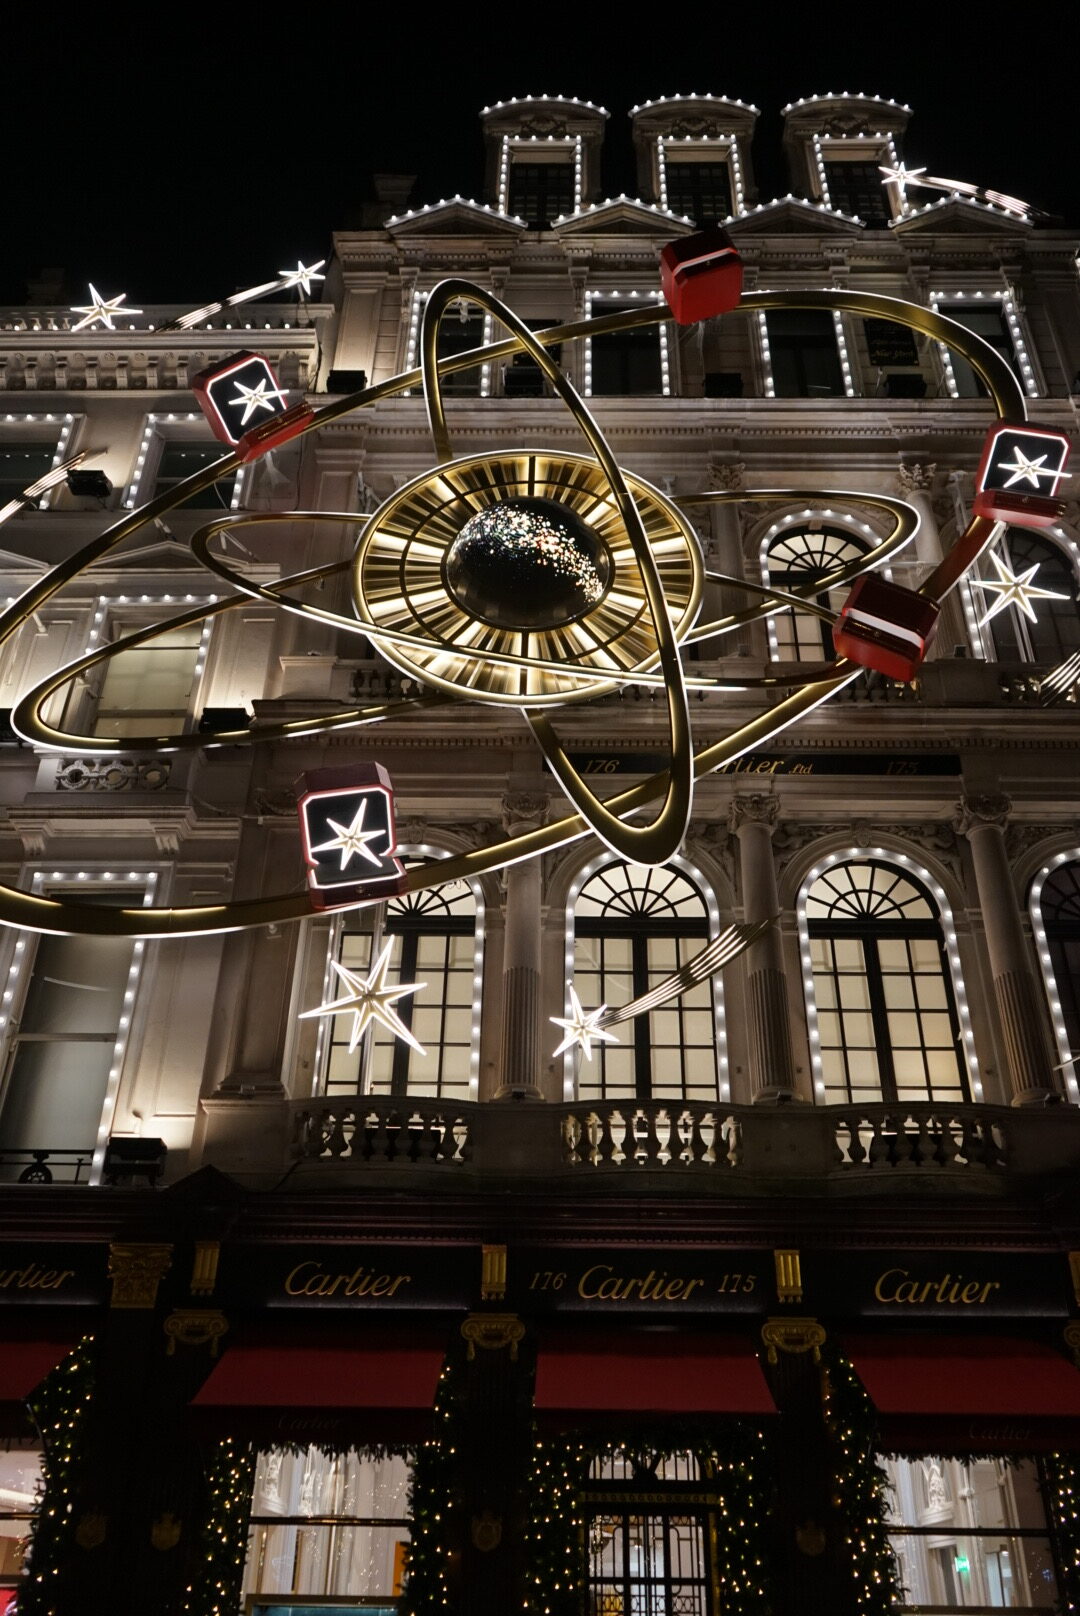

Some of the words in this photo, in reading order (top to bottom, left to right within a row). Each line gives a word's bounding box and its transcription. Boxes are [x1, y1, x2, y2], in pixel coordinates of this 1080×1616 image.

[584, 759, 620, 773] 176
[886, 760, 920, 775] 175
[0, 1262, 76, 1288] rtier
[284, 1260, 412, 1296] Cartier
[529, 1271, 567, 1290] 176
[577, 1264, 705, 1300] Cartier
[717, 1273, 757, 1293] 175
[874, 1268, 1000, 1304] Cartier
